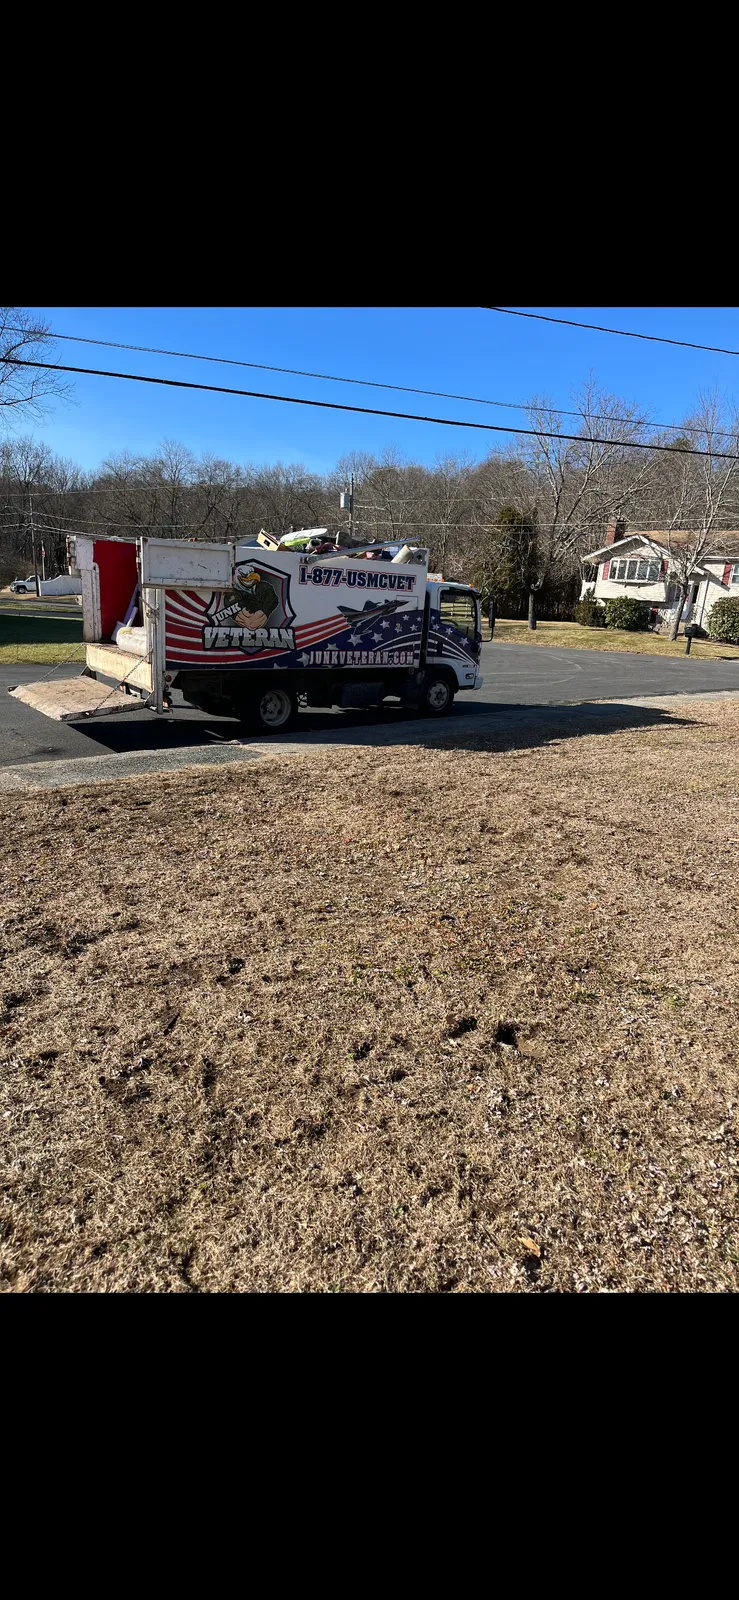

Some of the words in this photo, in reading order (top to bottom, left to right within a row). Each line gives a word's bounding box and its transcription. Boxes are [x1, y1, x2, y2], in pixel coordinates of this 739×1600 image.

[299, 565, 416, 591] 1-877-USMCVET
[211, 603, 242, 626] JUNK
[204, 627, 295, 649] VETERAN
[308, 650, 414, 666] JUNKVETERAN.COM
